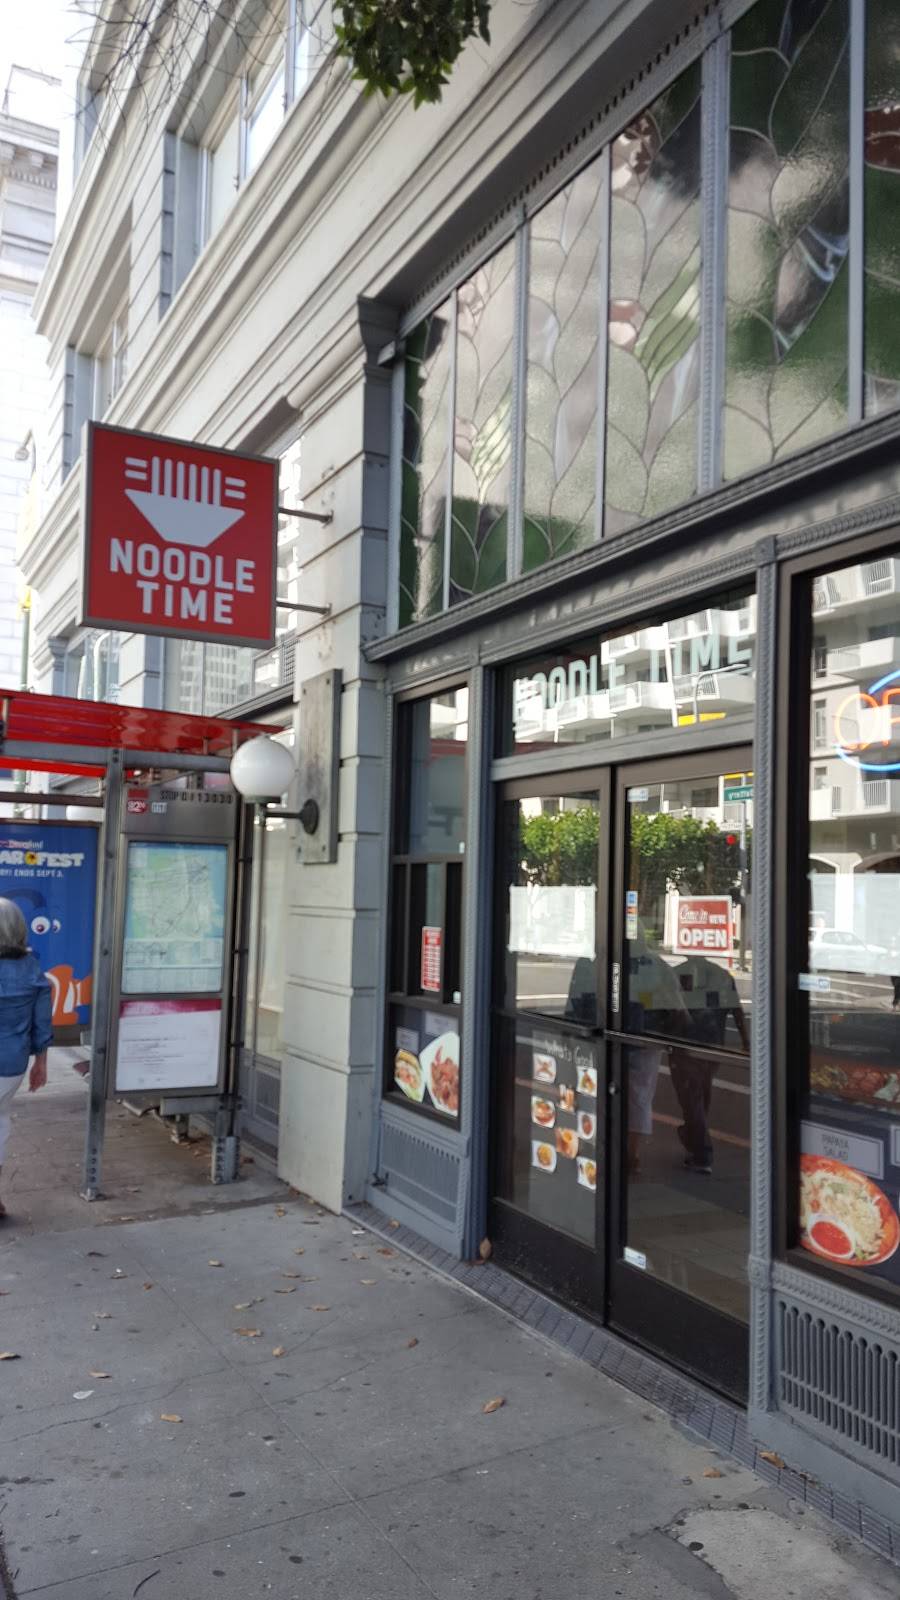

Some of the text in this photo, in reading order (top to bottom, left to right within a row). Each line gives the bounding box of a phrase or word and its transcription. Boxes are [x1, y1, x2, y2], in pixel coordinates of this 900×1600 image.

[110, 538, 255, 593] NOODLE
[136, 580, 234, 624] TIME
[679, 928, 728, 948] OPEN
